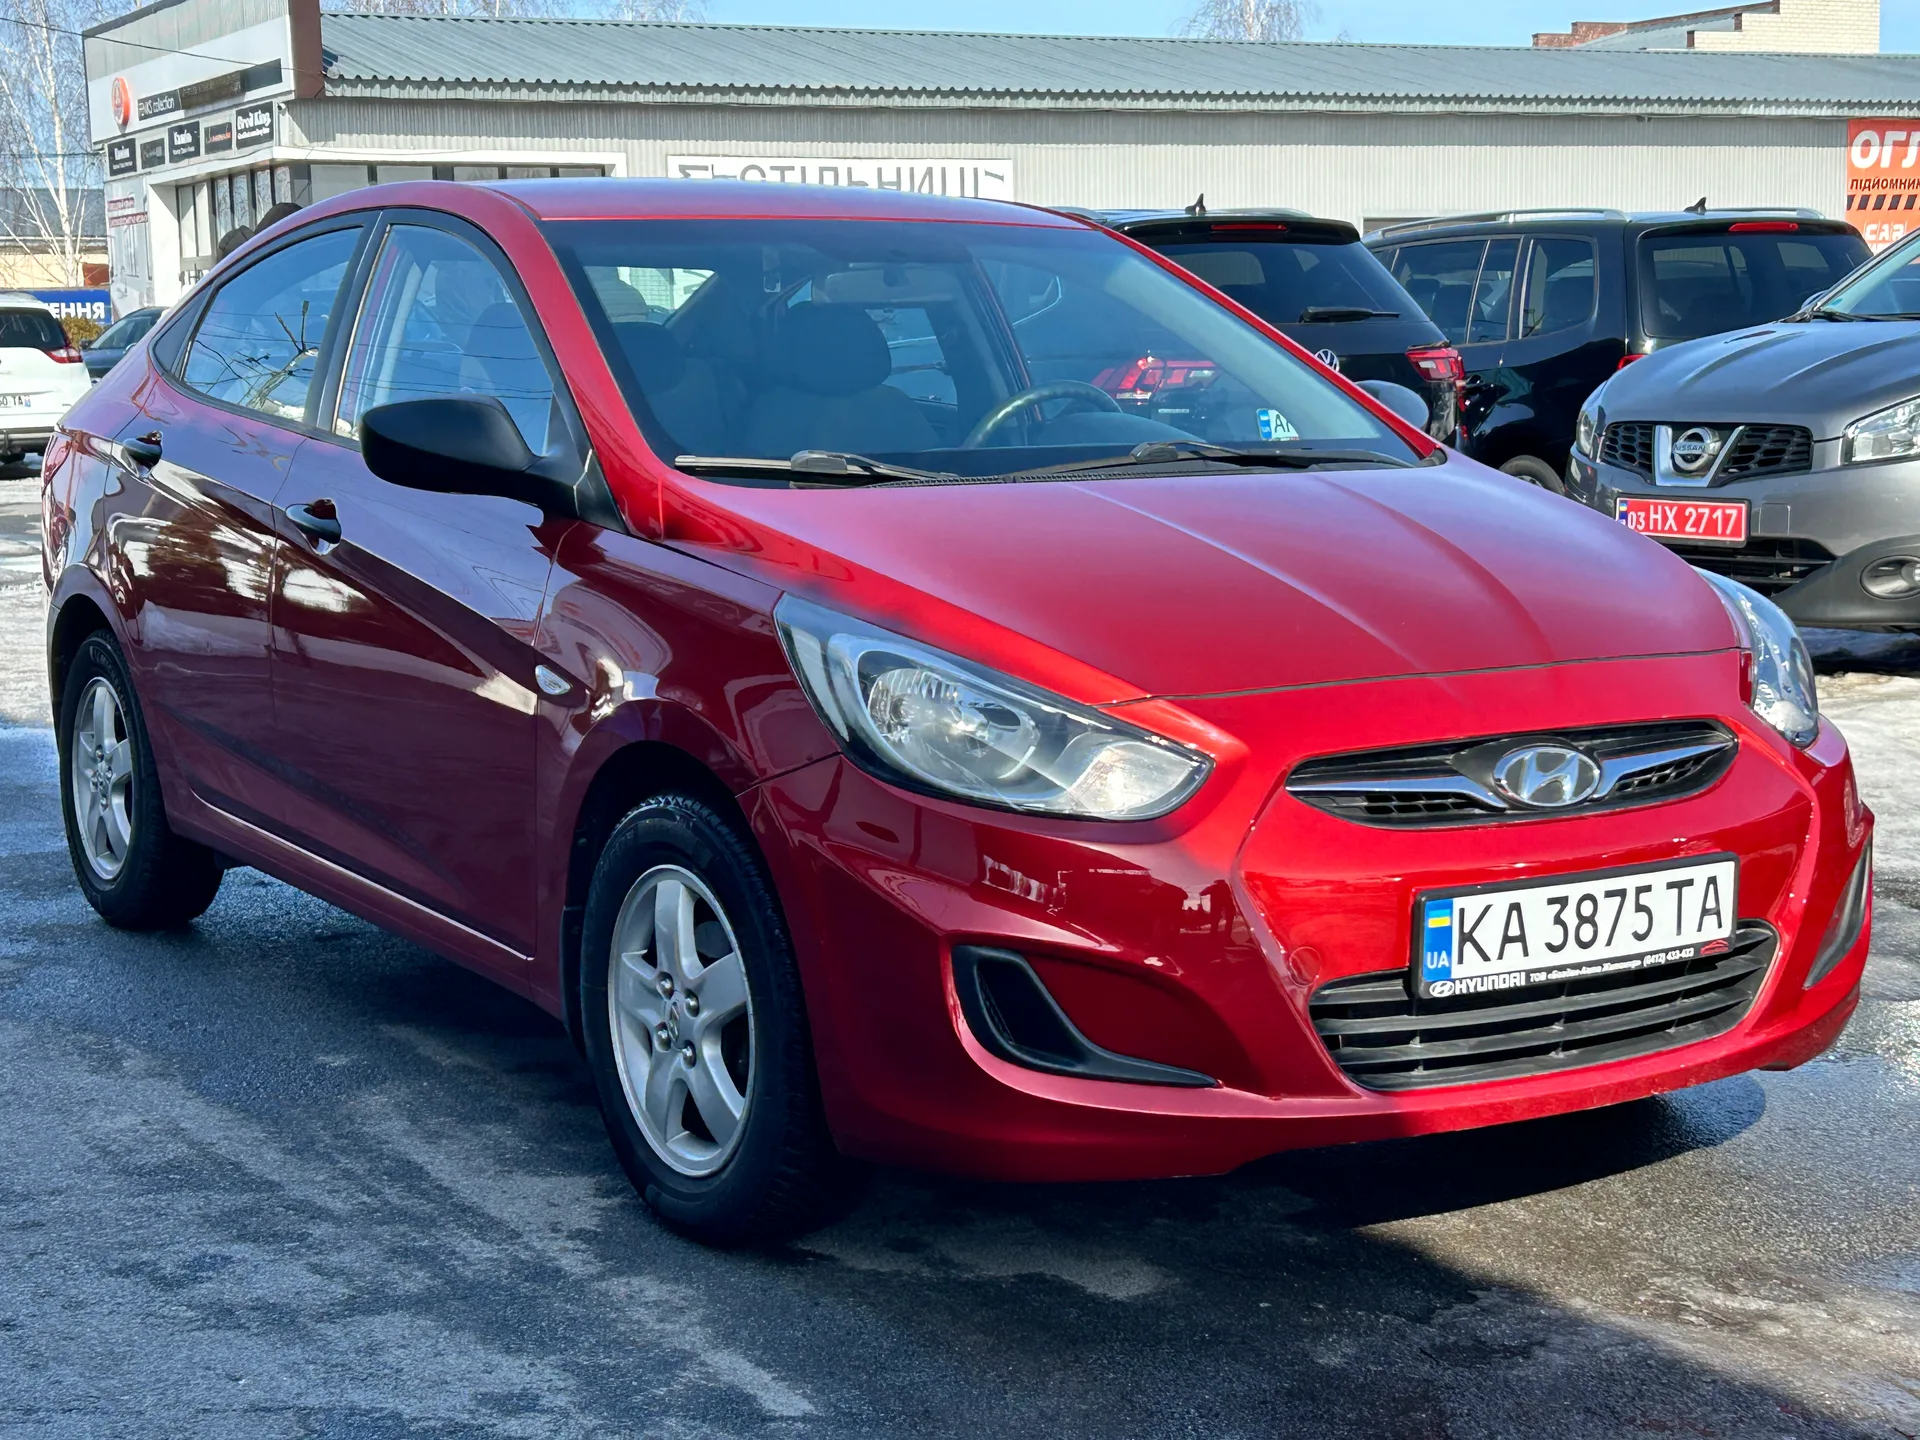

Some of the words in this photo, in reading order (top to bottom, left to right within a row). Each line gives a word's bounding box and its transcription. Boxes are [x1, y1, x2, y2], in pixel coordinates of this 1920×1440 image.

[1673, 442, 1706, 452] NISSAN
[1627, 511, 1646, 531] 03
[1649, 504, 1679, 532] HX
[1684, 506, 1739, 535] 2717
[1456, 902, 1530, 965] KA
[1544, 884, 1655, 953] 3875
[1665, 875, 1723, 937] TA
[1426, 950, 1450, 969] UA
[1454, 971, 1526, 995] HYUNDAI
